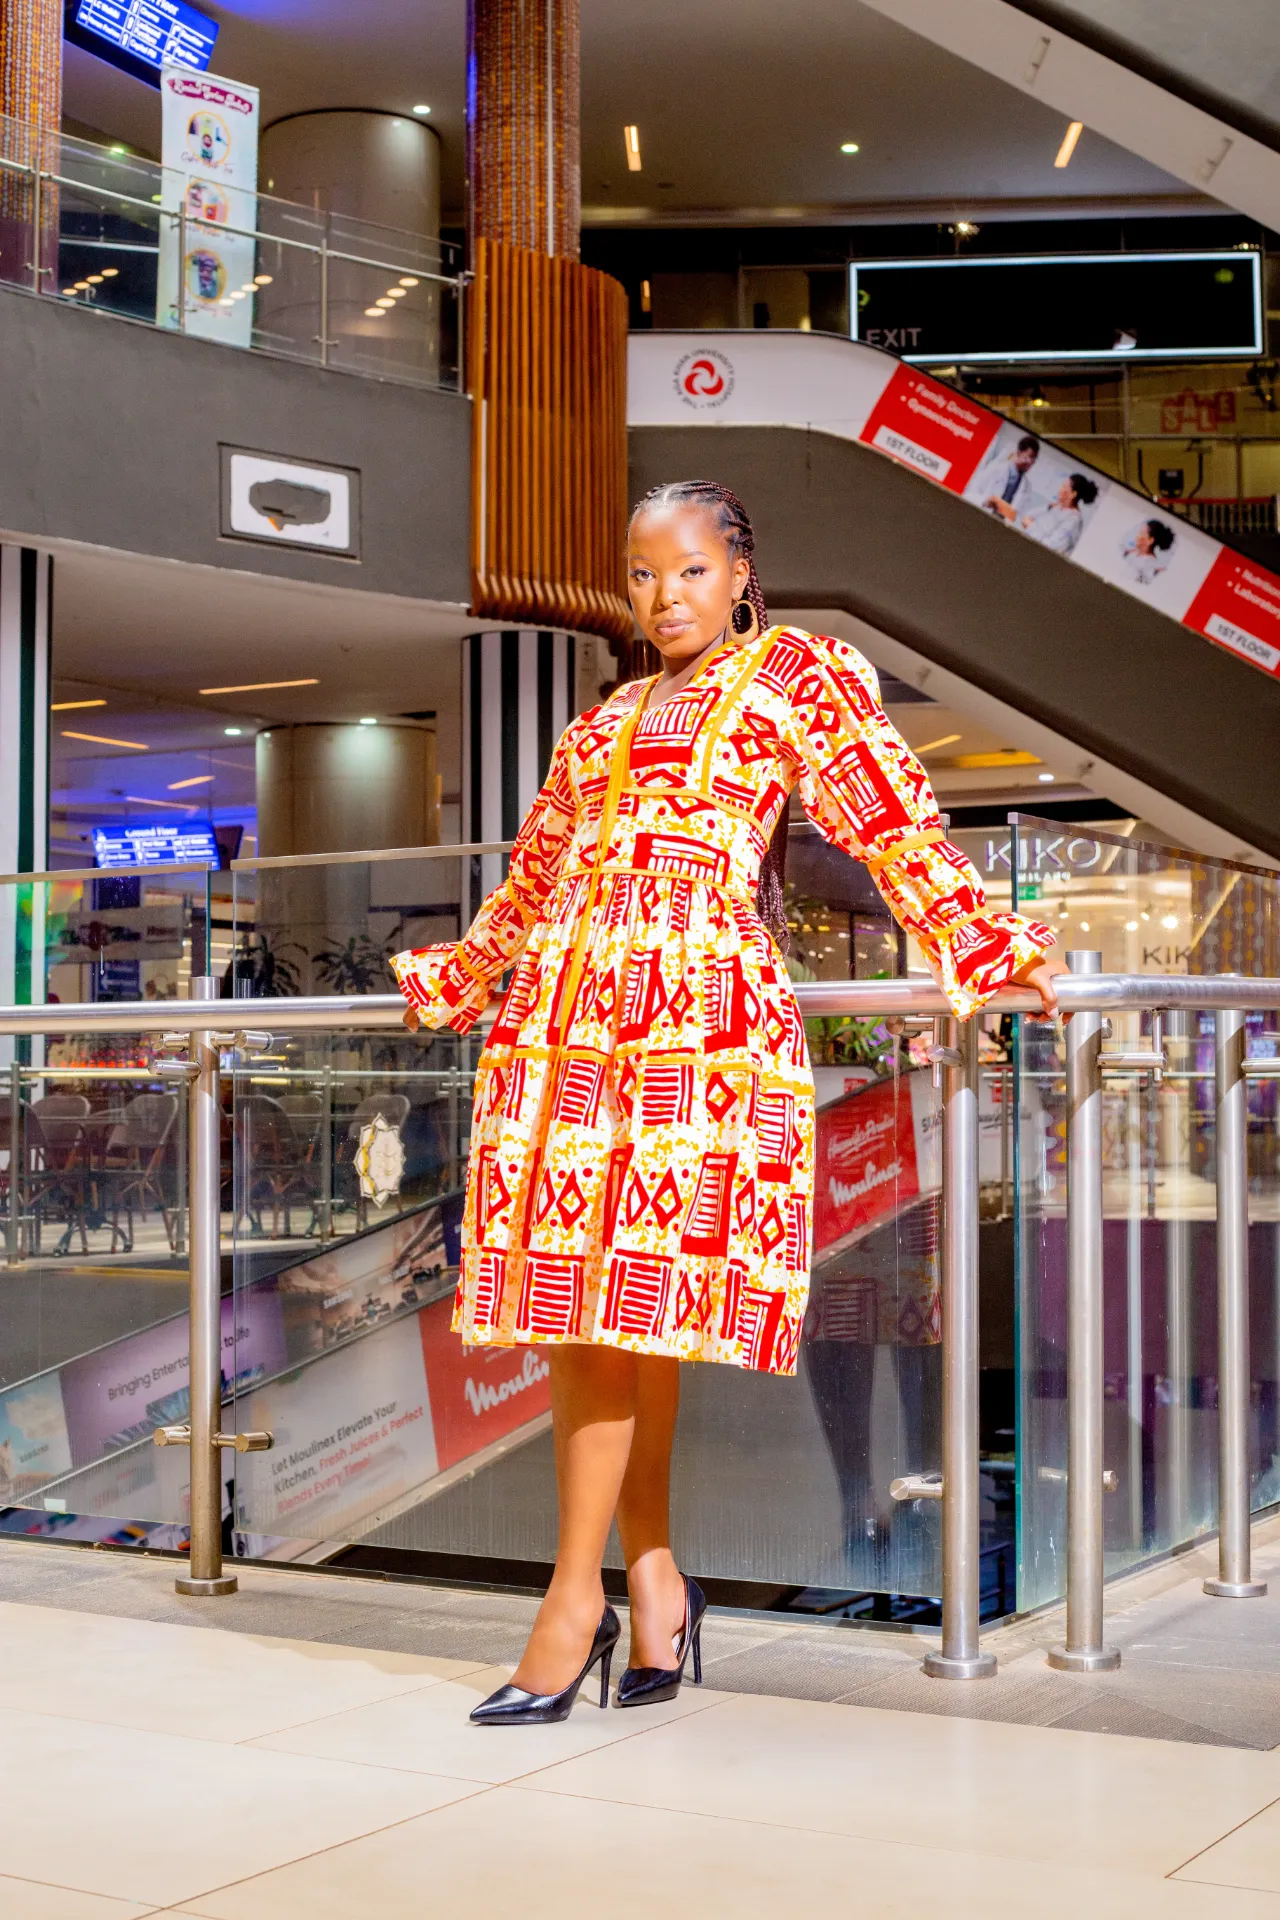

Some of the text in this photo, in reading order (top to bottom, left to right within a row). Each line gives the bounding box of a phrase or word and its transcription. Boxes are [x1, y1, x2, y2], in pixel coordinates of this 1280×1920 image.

[866, 327, 922, 347] EXIT
[1163, 393, 1232, 430] SALE
[903, 445, 940, 472] FLOOR
[1235, 635, 1273, 661] FLOOR
[985, 837, 1102, 872] KIKO
[828, 1156, 904, 1208] Moulinex
[107, 1372, 152, 1401] Bringing
[271, 1400, 397, 1476] Let Moulinex Elevate Your
[319, 1447, 347, 1471] Fresh
[348, 1430, 380, 1456] Juices
[389, 1405, 424, 1433] Perfect
[313, 1470, 343, 1496] Every
